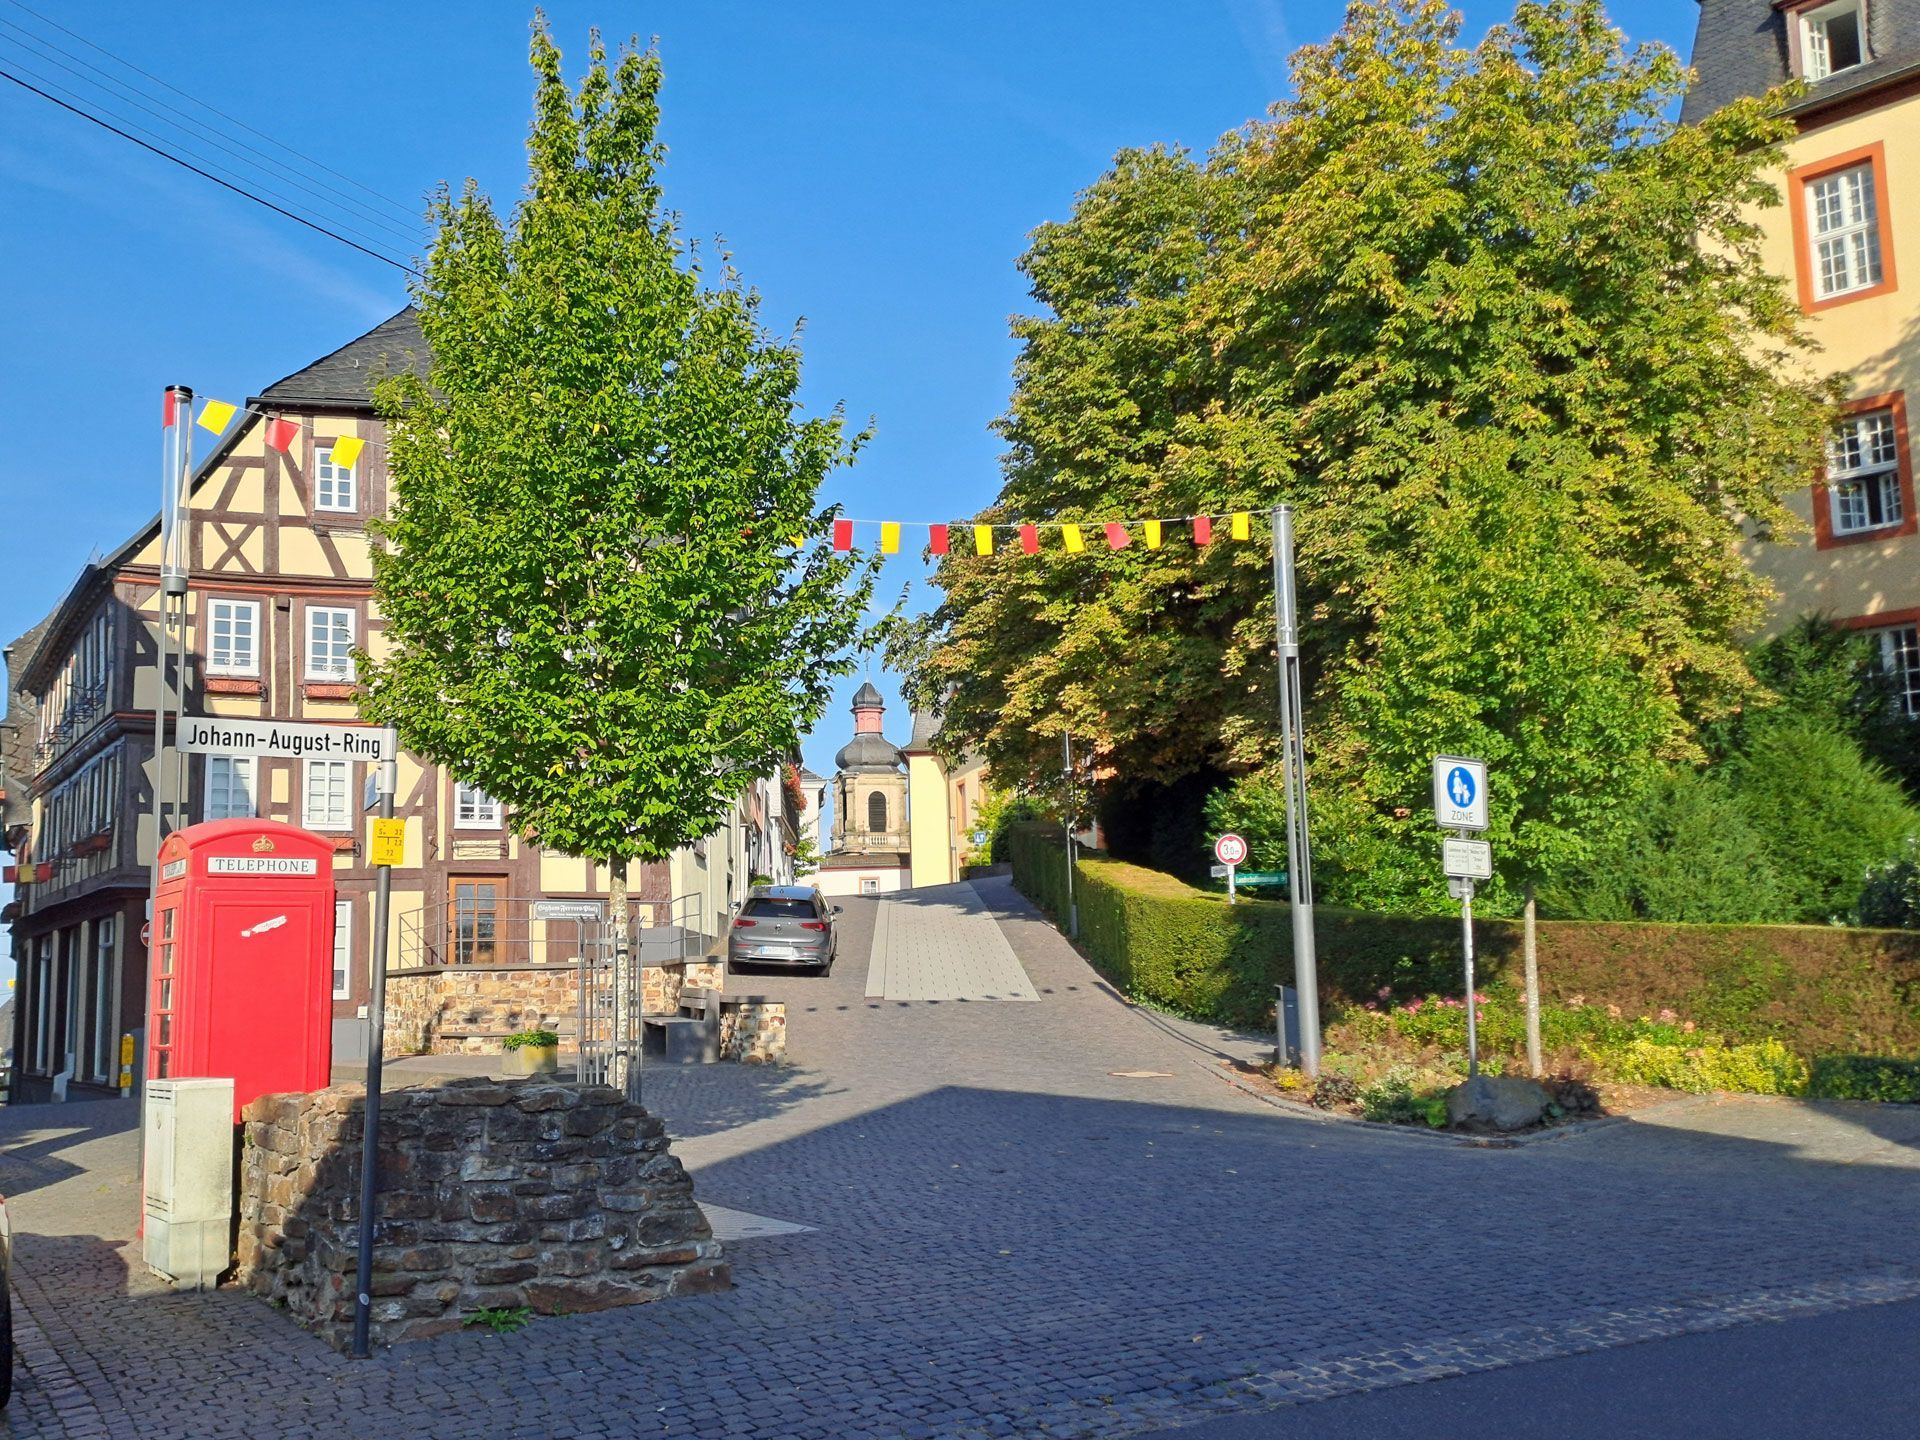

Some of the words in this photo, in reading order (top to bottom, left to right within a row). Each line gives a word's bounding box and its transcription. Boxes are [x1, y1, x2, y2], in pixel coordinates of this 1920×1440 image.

[187, 724, 380, 759] Johann-August-Ring
[1451, 810, 1474, 822] ZONE
[215, 858, 309, 873] TELEPHONE
